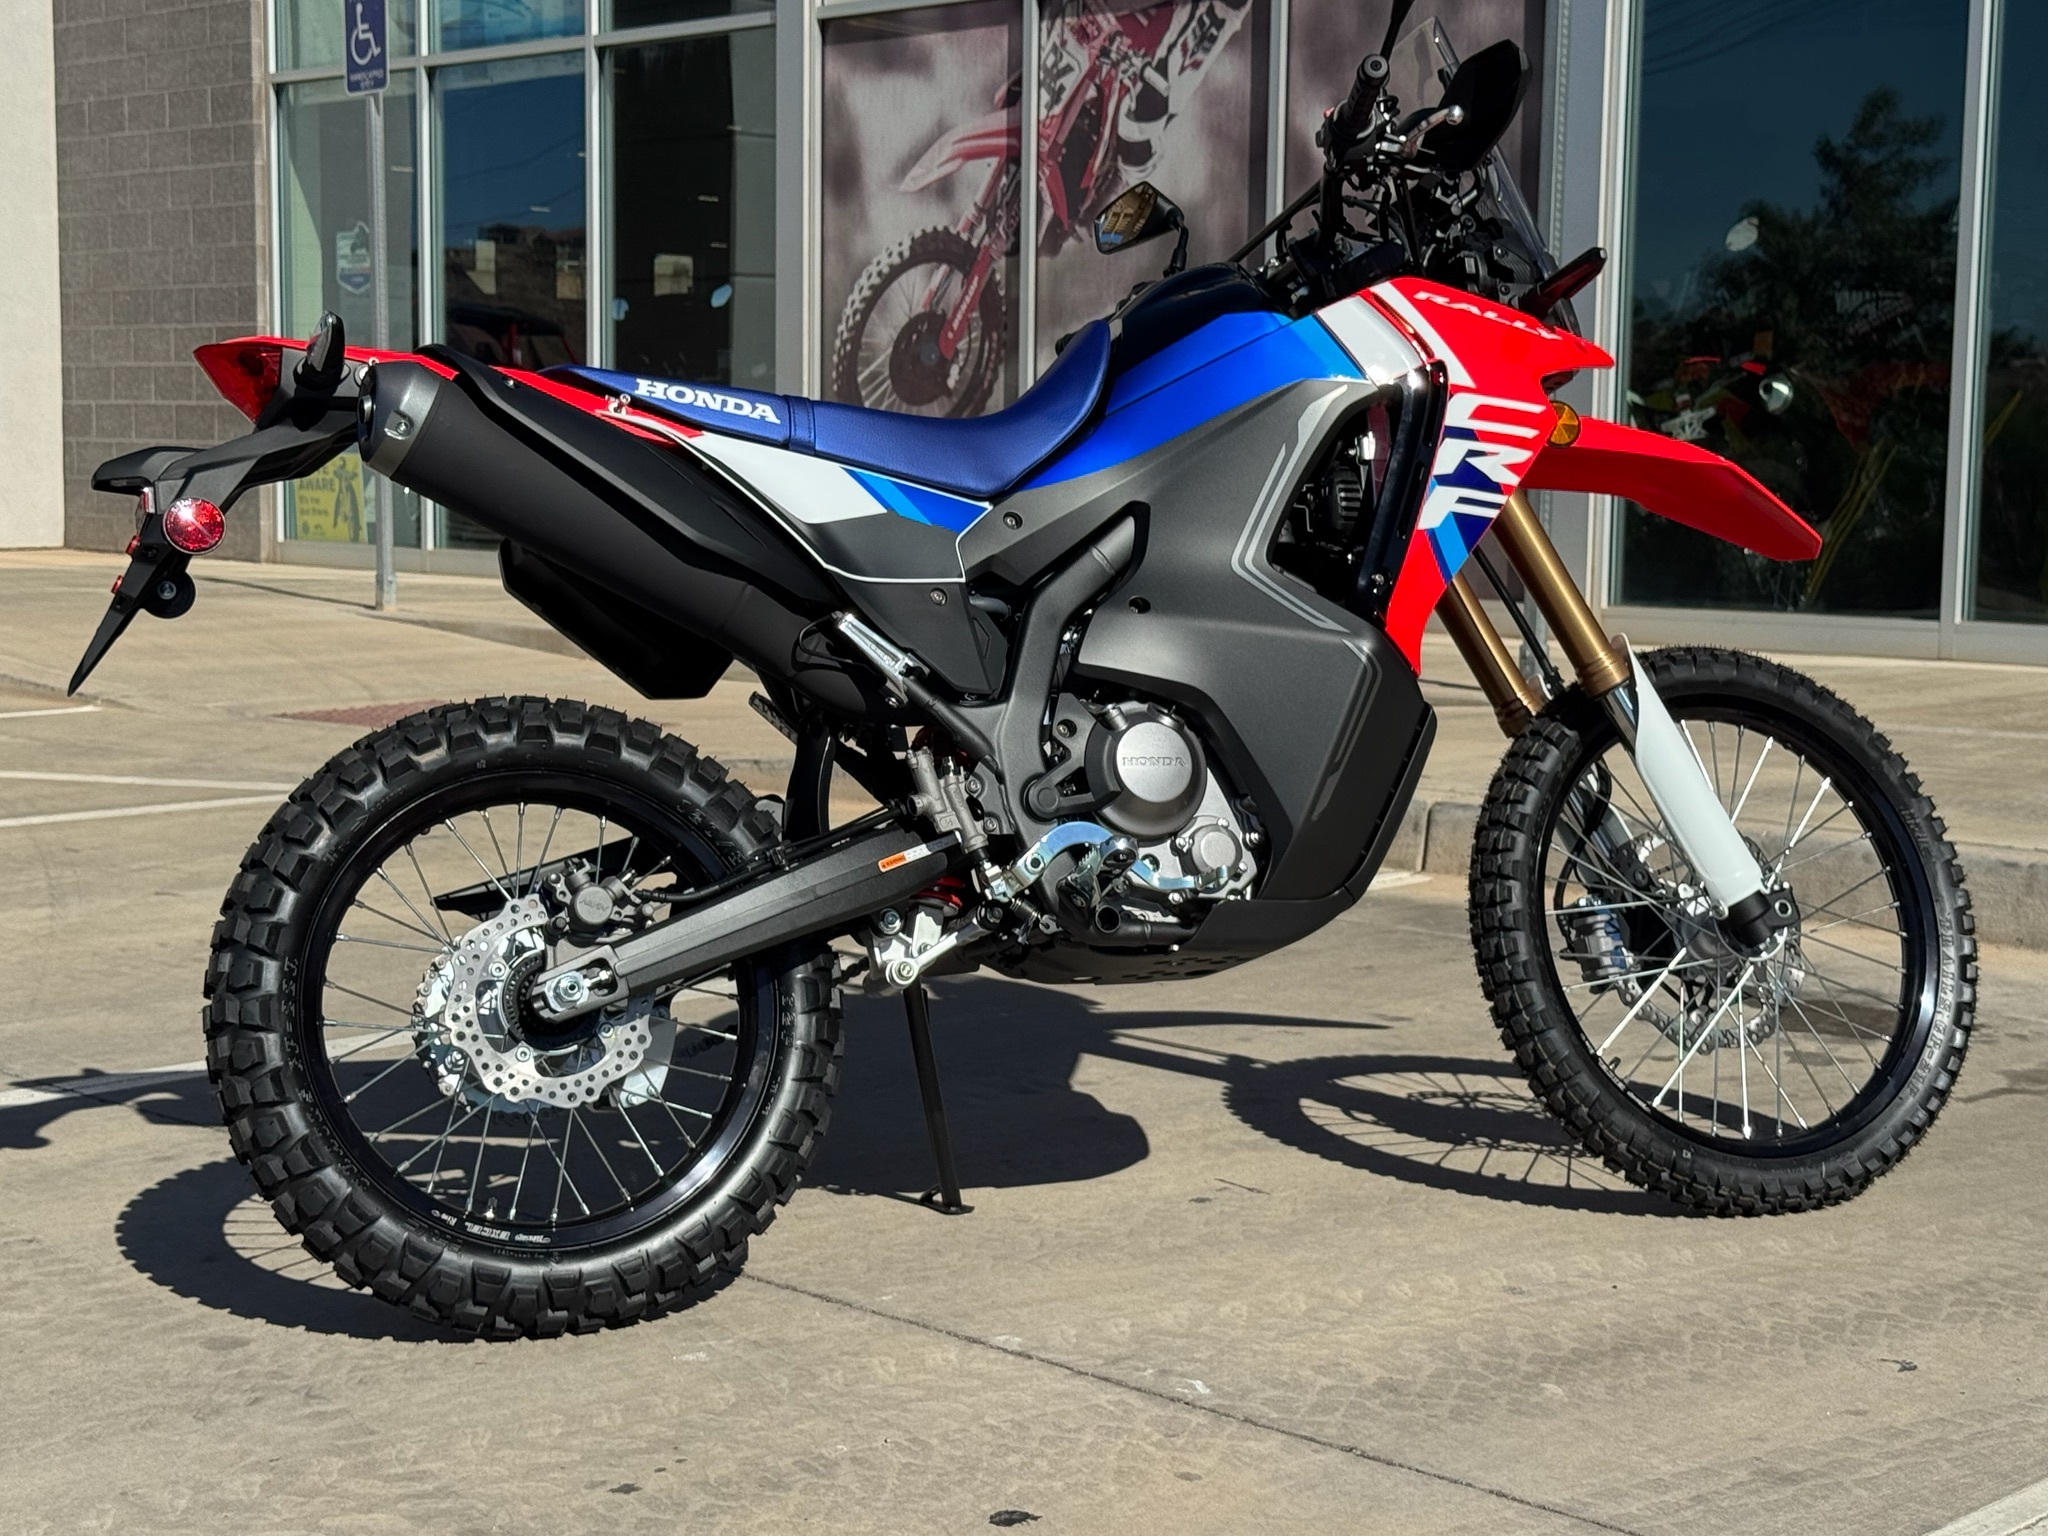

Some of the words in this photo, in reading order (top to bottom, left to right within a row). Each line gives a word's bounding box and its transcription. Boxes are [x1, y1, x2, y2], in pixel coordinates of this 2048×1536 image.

[1413, 290, 1564, 341] RALLY
[635, 378, 781, 424] HONDA
[1417, 392, 1547, 530] CRF
[1122, 756, 1188, 768] HONDA
